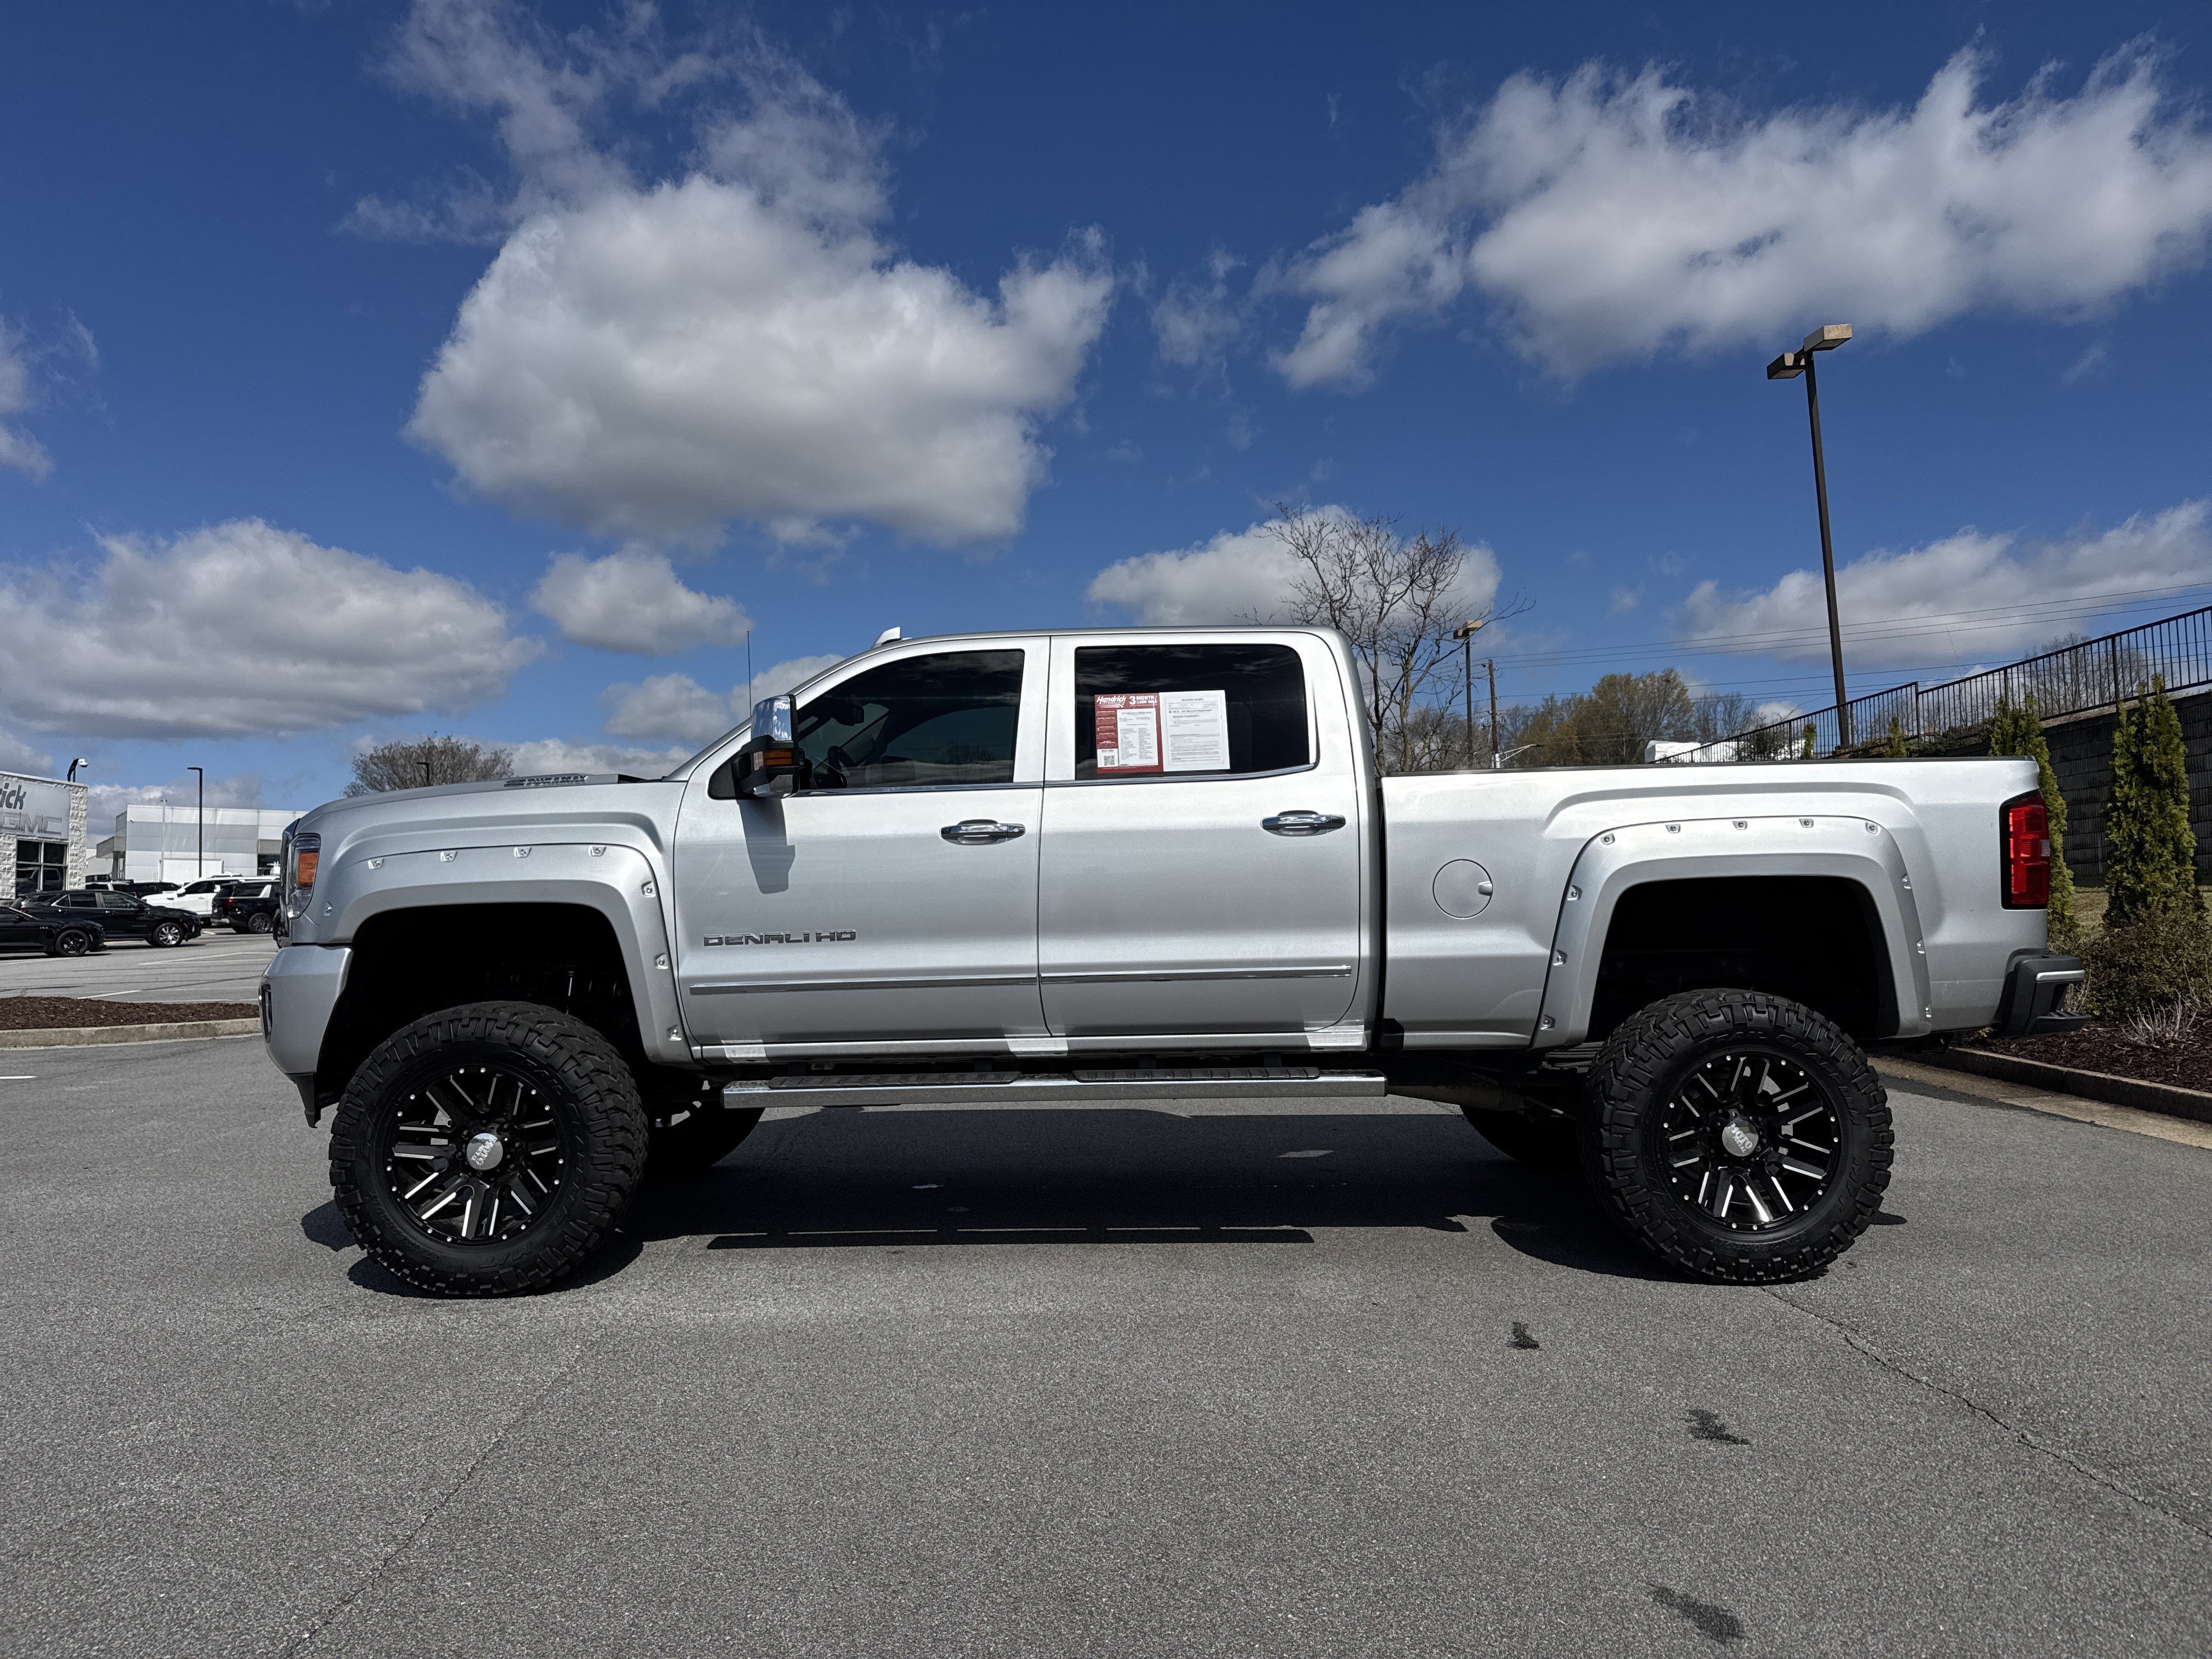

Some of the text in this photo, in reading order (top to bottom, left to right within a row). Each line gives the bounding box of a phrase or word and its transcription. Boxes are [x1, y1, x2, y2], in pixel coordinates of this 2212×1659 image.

[1130, 696, 1136, 705] 3
[0, 782, 26, 810] ick
[0, 812, 62, 836] GMC
[703, 929, 856, 946] DENALI HD
[1728, 1122, 1753, 1150] MOTO
